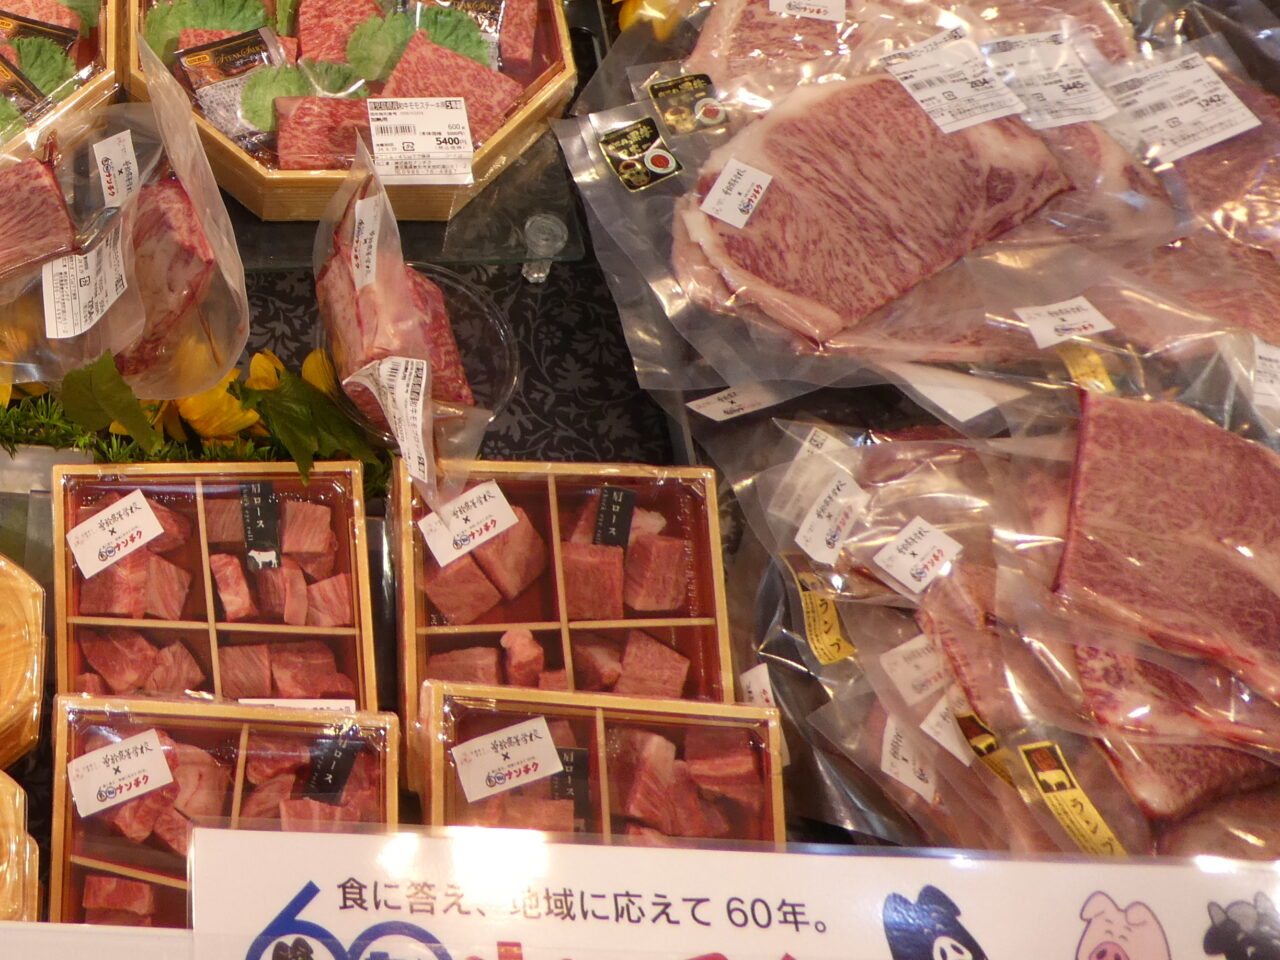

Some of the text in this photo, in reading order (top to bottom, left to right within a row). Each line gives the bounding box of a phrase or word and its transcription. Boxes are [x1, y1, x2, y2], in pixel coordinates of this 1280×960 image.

[113, 530, 144, 554] ナンチク
[505, 761, 540, 781] ナンチク
[115, 773, 151, 796] ナンチク
